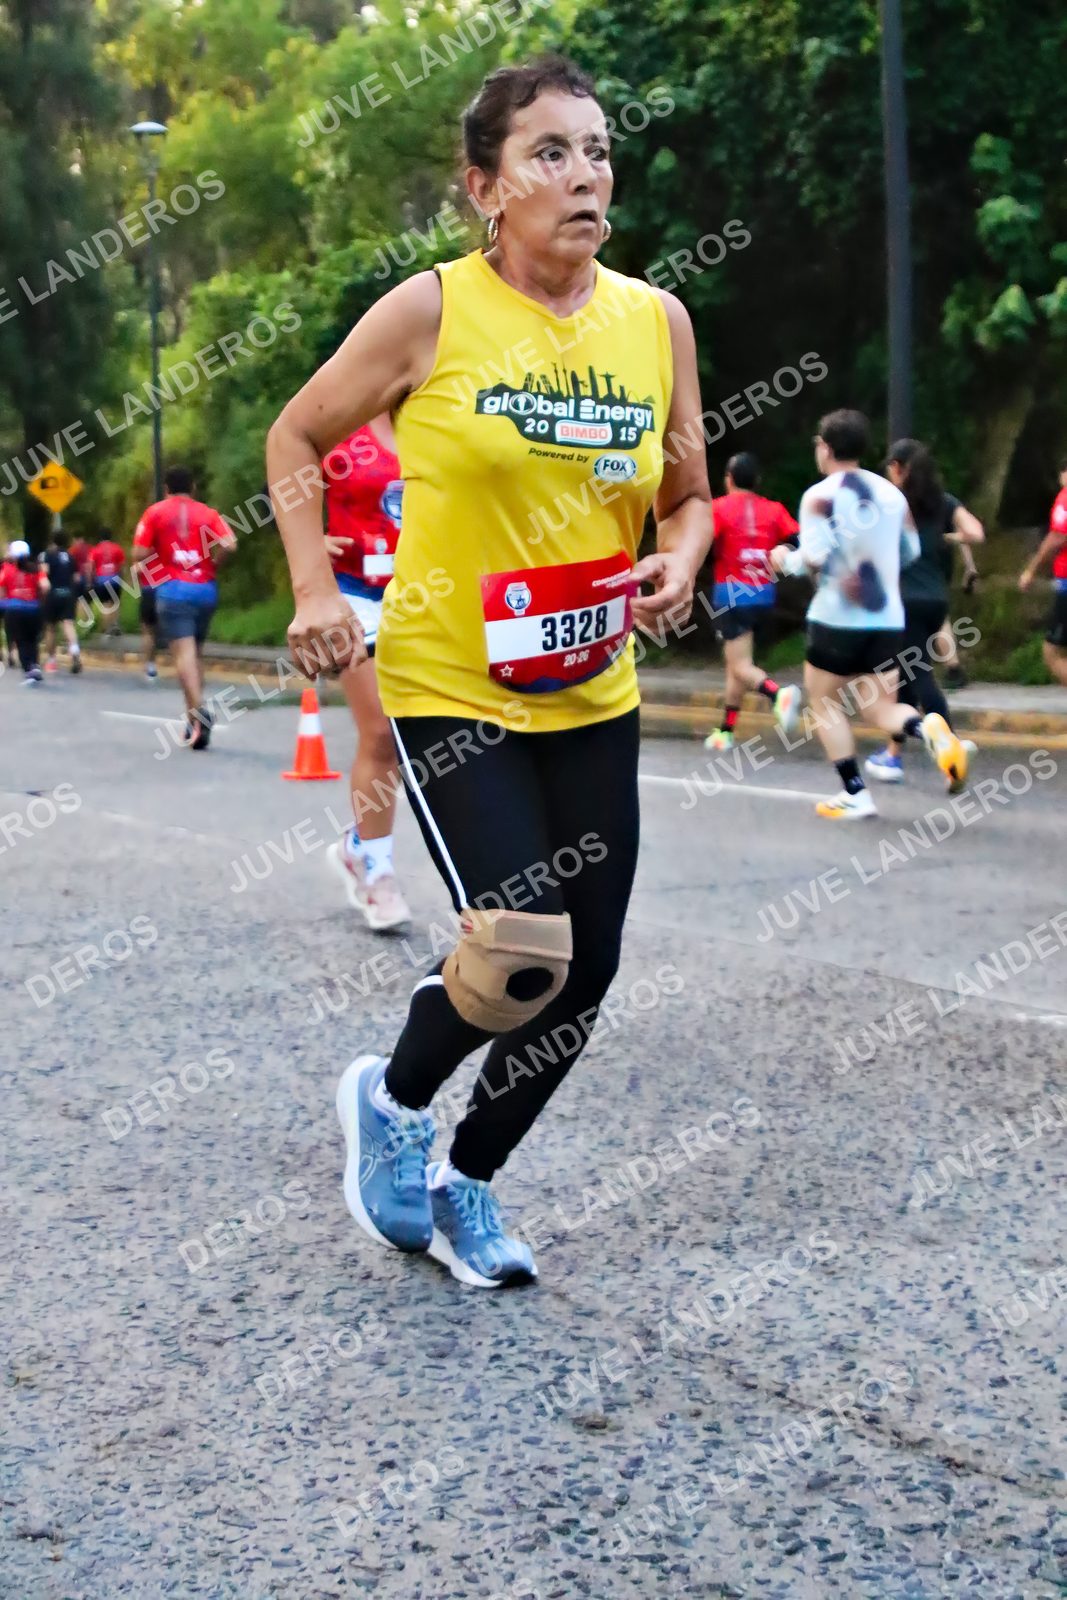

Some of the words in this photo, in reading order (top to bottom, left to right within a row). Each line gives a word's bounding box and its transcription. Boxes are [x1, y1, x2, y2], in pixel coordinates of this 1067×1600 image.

[580, 398, 653, 428] Energy
[524, 418, 549, 433] 20
[560, 425, 608, 440] BIMBO
[619, 427, 637, 442] 15
[528, 448, 574, 462] Powered
[576, 454, 589, 464] by
[603, 459, 627, 472] FOX
[541, 605, 608, 651] 3328
